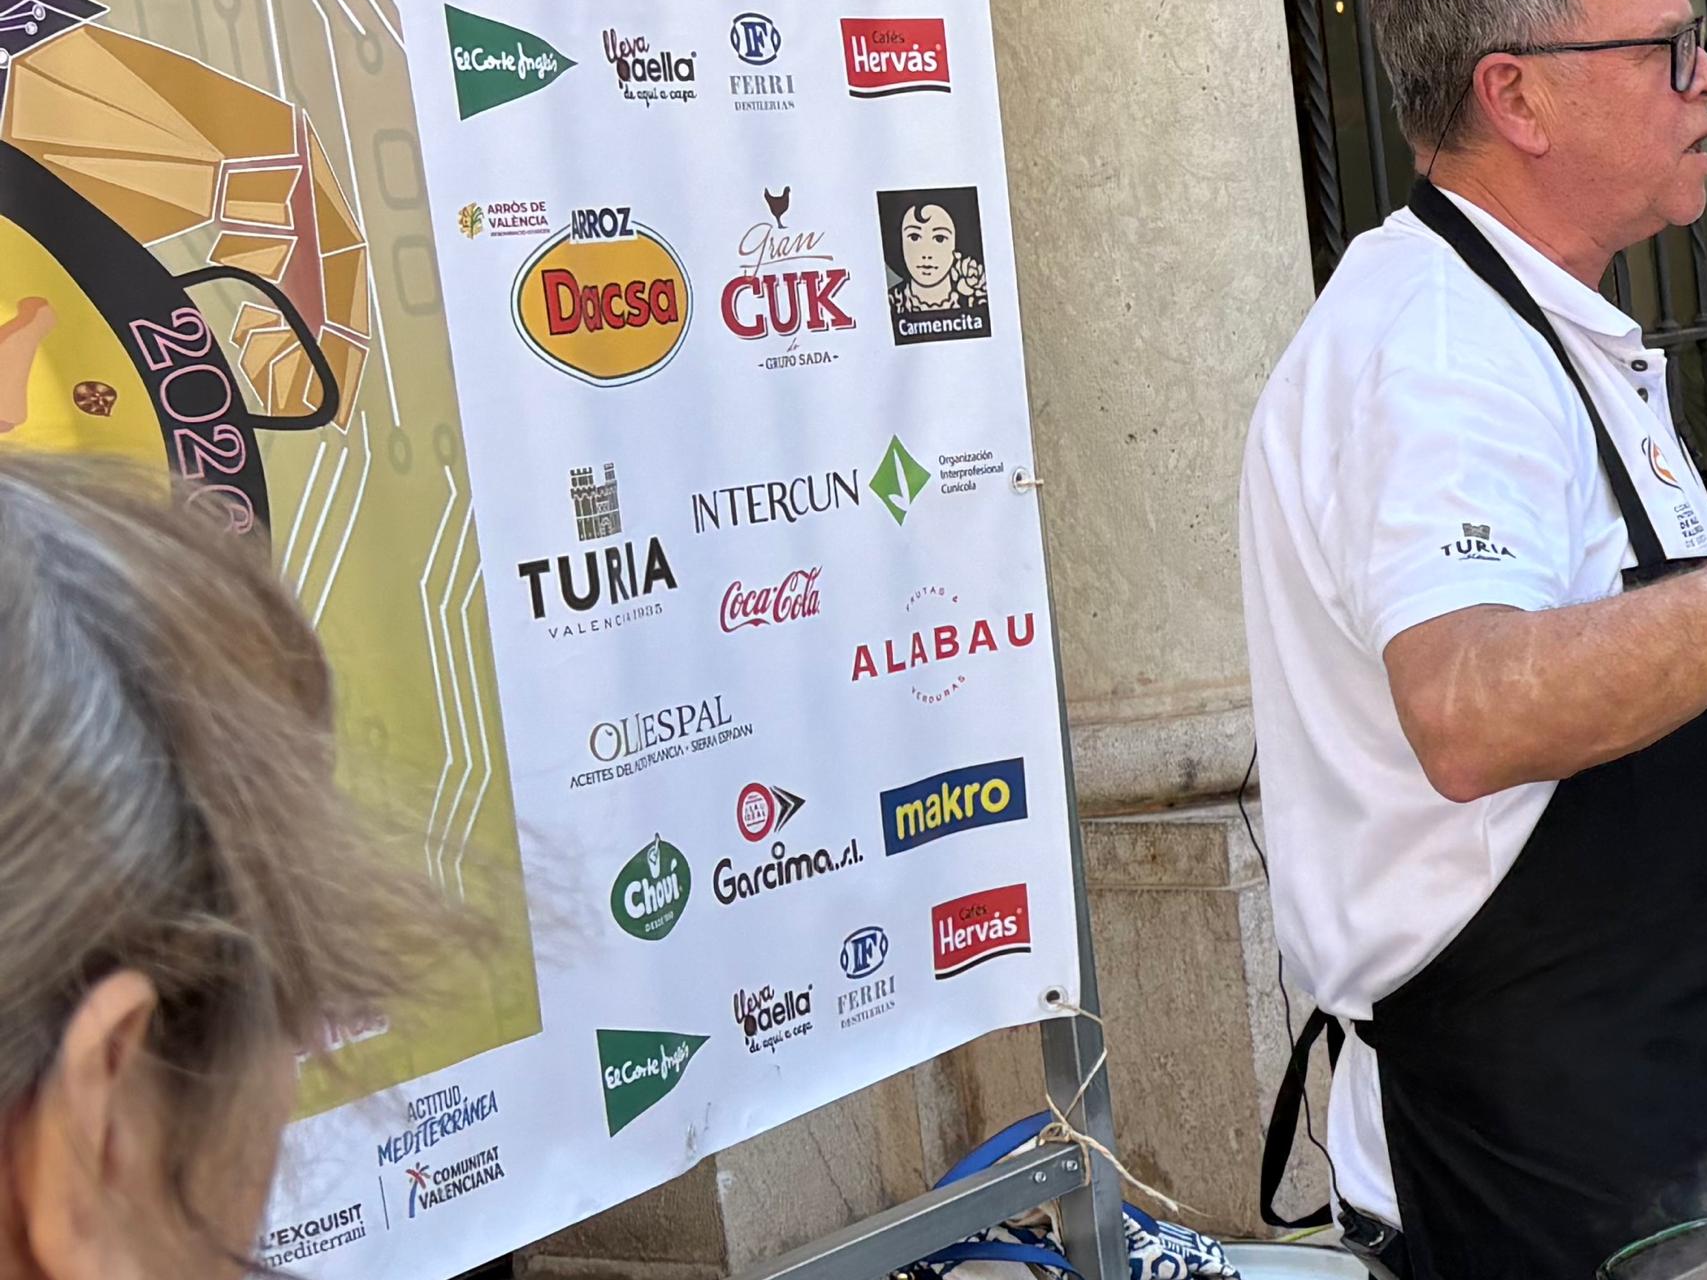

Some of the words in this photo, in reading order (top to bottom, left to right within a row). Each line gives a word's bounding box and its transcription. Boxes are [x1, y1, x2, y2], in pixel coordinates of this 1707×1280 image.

[471, 47, 516, 71] Corte
[851, 35, 938, 76] Hervás
[729, 74, 795, 95] FERRI
[487, 200, 528, 215] ARRÒS
[530, 201, 546, 212] DE
[488, 215, 549, 228] VALÈNCIA
[571, 207, 634, 240] ARROZ
[738, 222, 826, 280] Gran
[541, 268, 679, 336] Dacsa
[720, 269, 857, 341] CUK
[898, 313, 983, 336] Carmencita
[765, 355, 797, 370] GRUPO
[799, 352, 832, 367] SADA
[938, 450, 993, 467] Organización
[940, 462, 1004, 480] Interprofesional
[692, 469, 860, 534] INTERCUN
[1440, 539, 1516, 559] TURIA
[518, 537, 678, 620] TURIA
[548, 612, 632, 640] VALENCIA
[852, 613, 1035, 682] ALABAU
[911, 674, 966, 704] VERDURAS
[570, 767, 614, 789] ACEITES
[616, 763, 633, 779] DEL
[691, 735, 718, 753] SIERRA
[895, 778, 1010, 840] makro
[624, 858, 680, 919] Choví
[939, 913, 1018, 956] Hervás
[837, 975, 895, 1015] FERRI
[621, 1058, 660, 1084] Corte
[407, 1085, 462, 1123] ACTITUD
[433, 1145, 499, 1186] COMUNITAT
[418, 1163, 505, 1210] VALENCIANA
[259, 1203, 362, 1251] L'EXQUISIT
[263, 1221, 367, 1268] mediterrani
